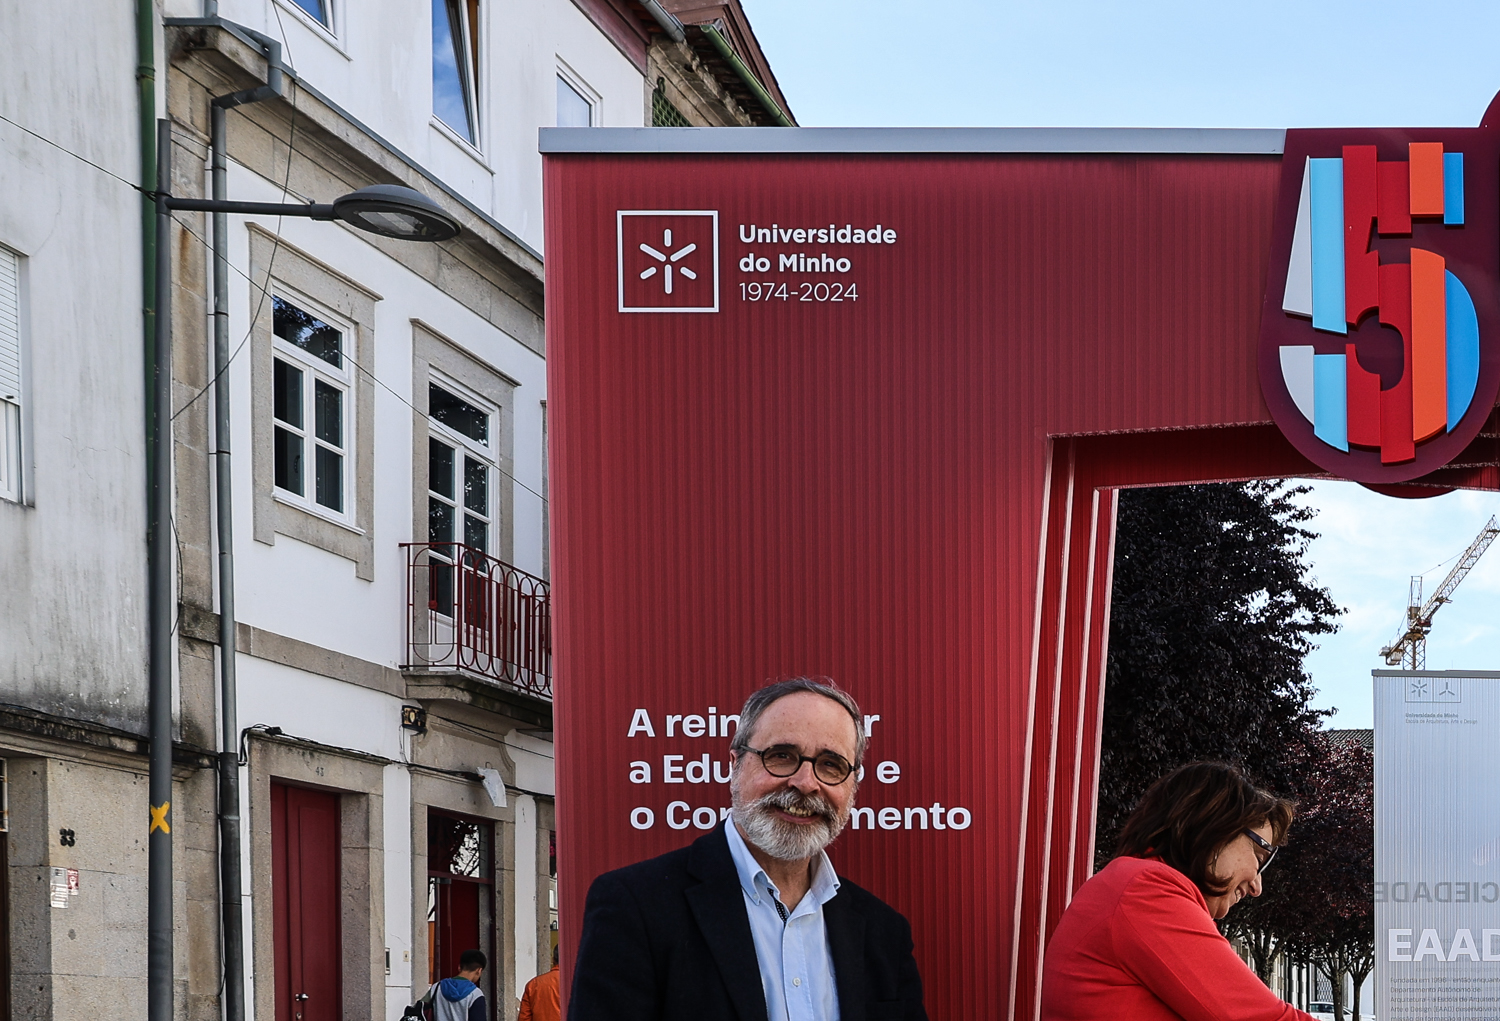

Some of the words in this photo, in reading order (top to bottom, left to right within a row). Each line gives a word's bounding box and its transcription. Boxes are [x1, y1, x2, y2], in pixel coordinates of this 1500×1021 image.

[739, 224, 897, 244] Universidade
[739, 253, 771, 272] do
[778, 253, 851, 272] Minho
[739, 282, 858, 301] 1974-2024
[627, 708, 655, 738] A
[629, 760, 651, 783] a
[876, 760, 901, 784] e
[630, 806, 655, 830] o
